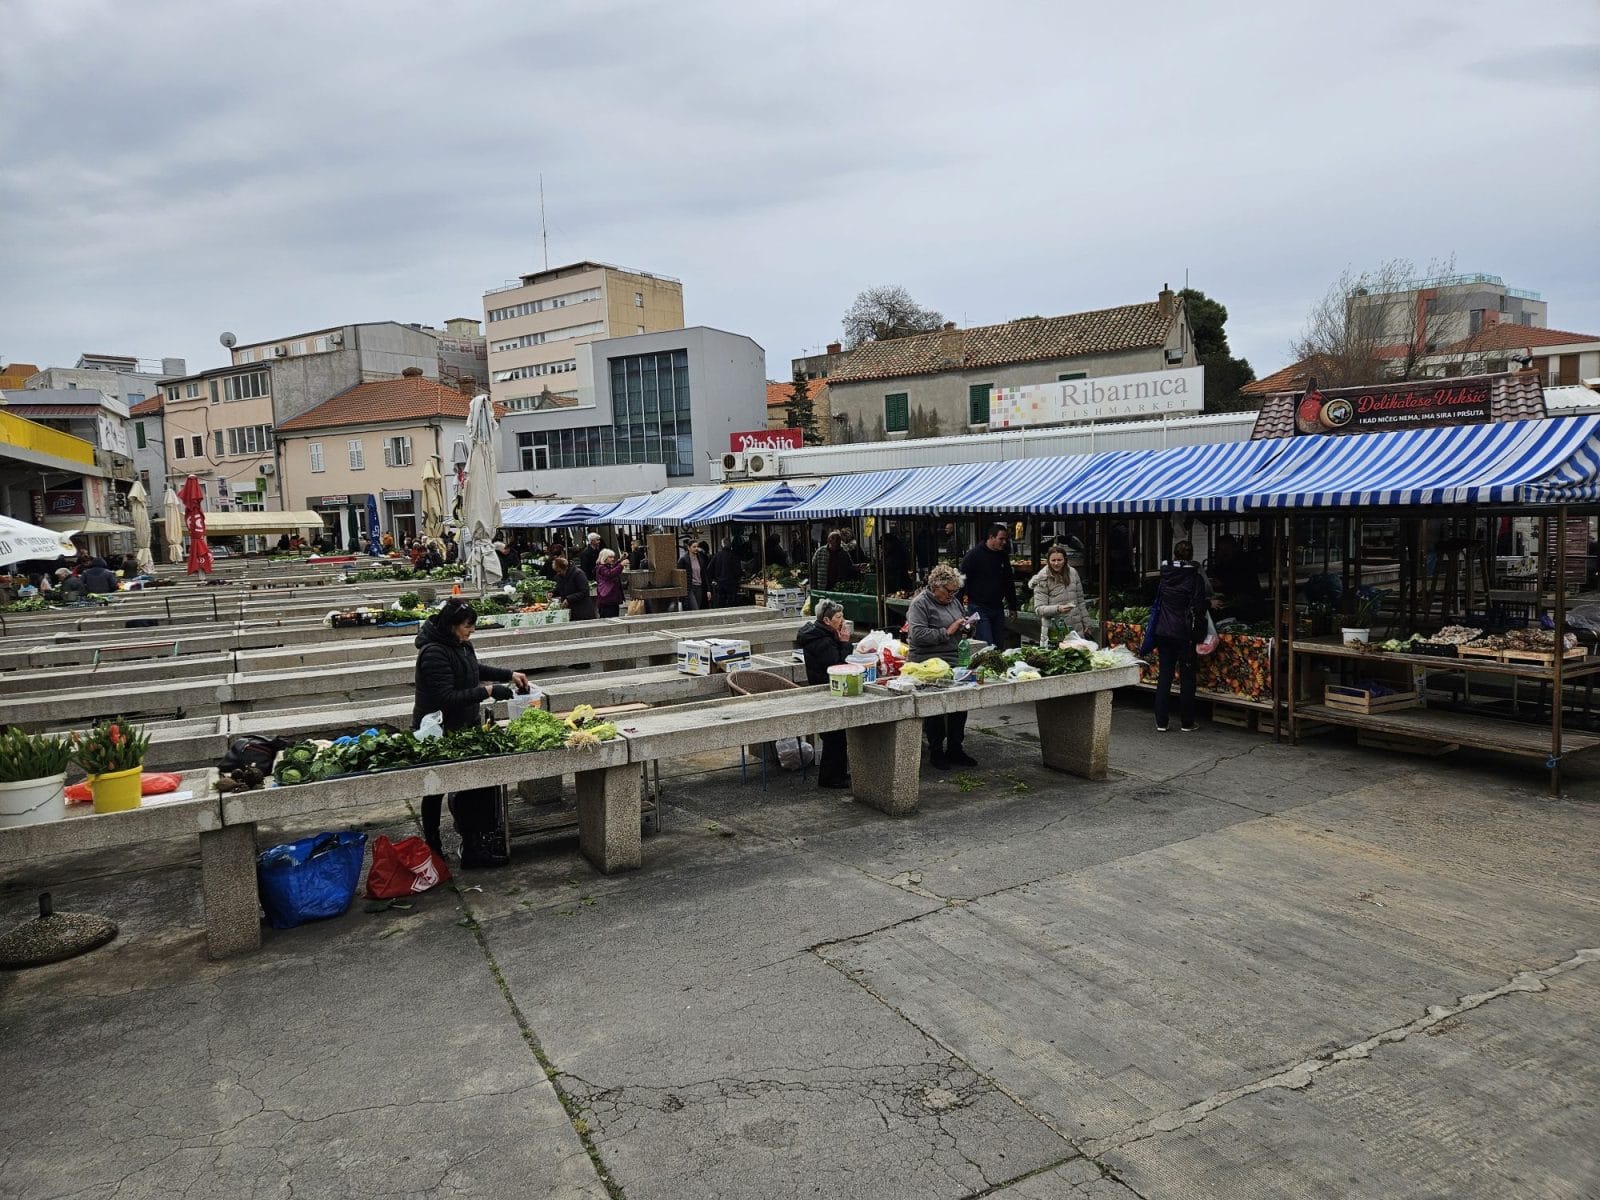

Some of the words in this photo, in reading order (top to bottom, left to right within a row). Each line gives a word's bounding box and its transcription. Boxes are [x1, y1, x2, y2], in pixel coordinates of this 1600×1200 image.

[1060, 377, 1188, 407] Ribarnica
[1358, 392, 1431, 413] Delikatese
[1378, 415, 1398, 423] NIČEG
[1457, 409, 1485, 418] PRŠUTA
